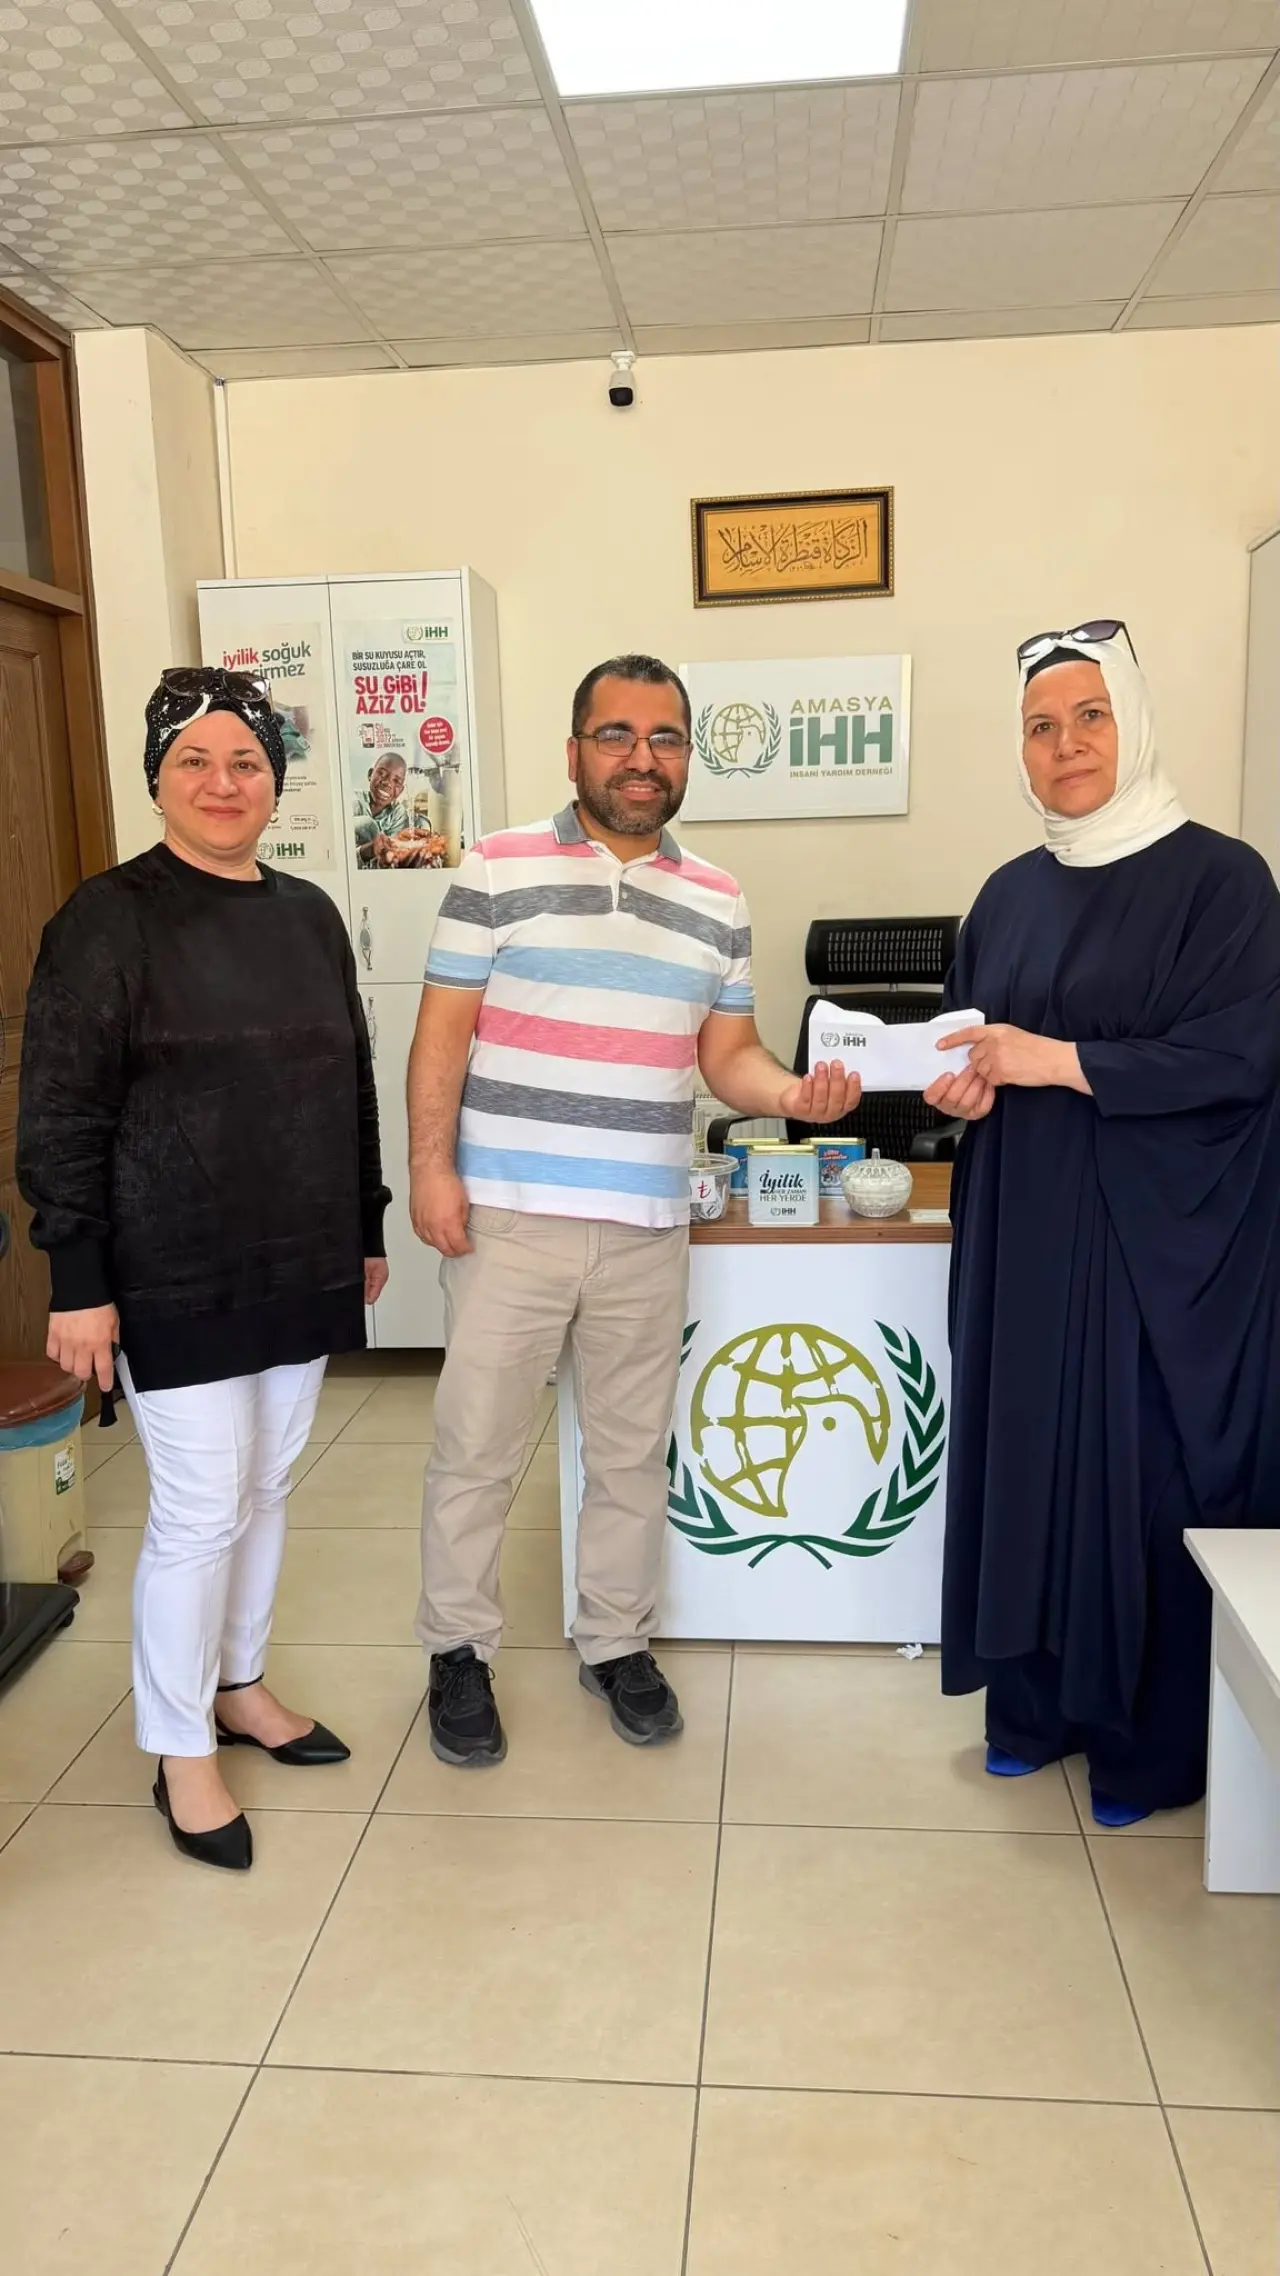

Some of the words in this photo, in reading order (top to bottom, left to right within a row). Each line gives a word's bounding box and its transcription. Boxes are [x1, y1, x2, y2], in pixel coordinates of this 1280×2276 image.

[223, 648, 259, 670] iyilik
[262, 641, 311, 664] soğuk
[364, 651, 374, 660] SU
[375, 650, 403, 660] KUYUSU
[396, 661, 416, 672] ÇARE
[417, 660, 427, 669] OL
[354, 675, 378, 695] SU
[790, 695, 893, 714] AMASYA
[821, 768, 853, 777] YARDIM
